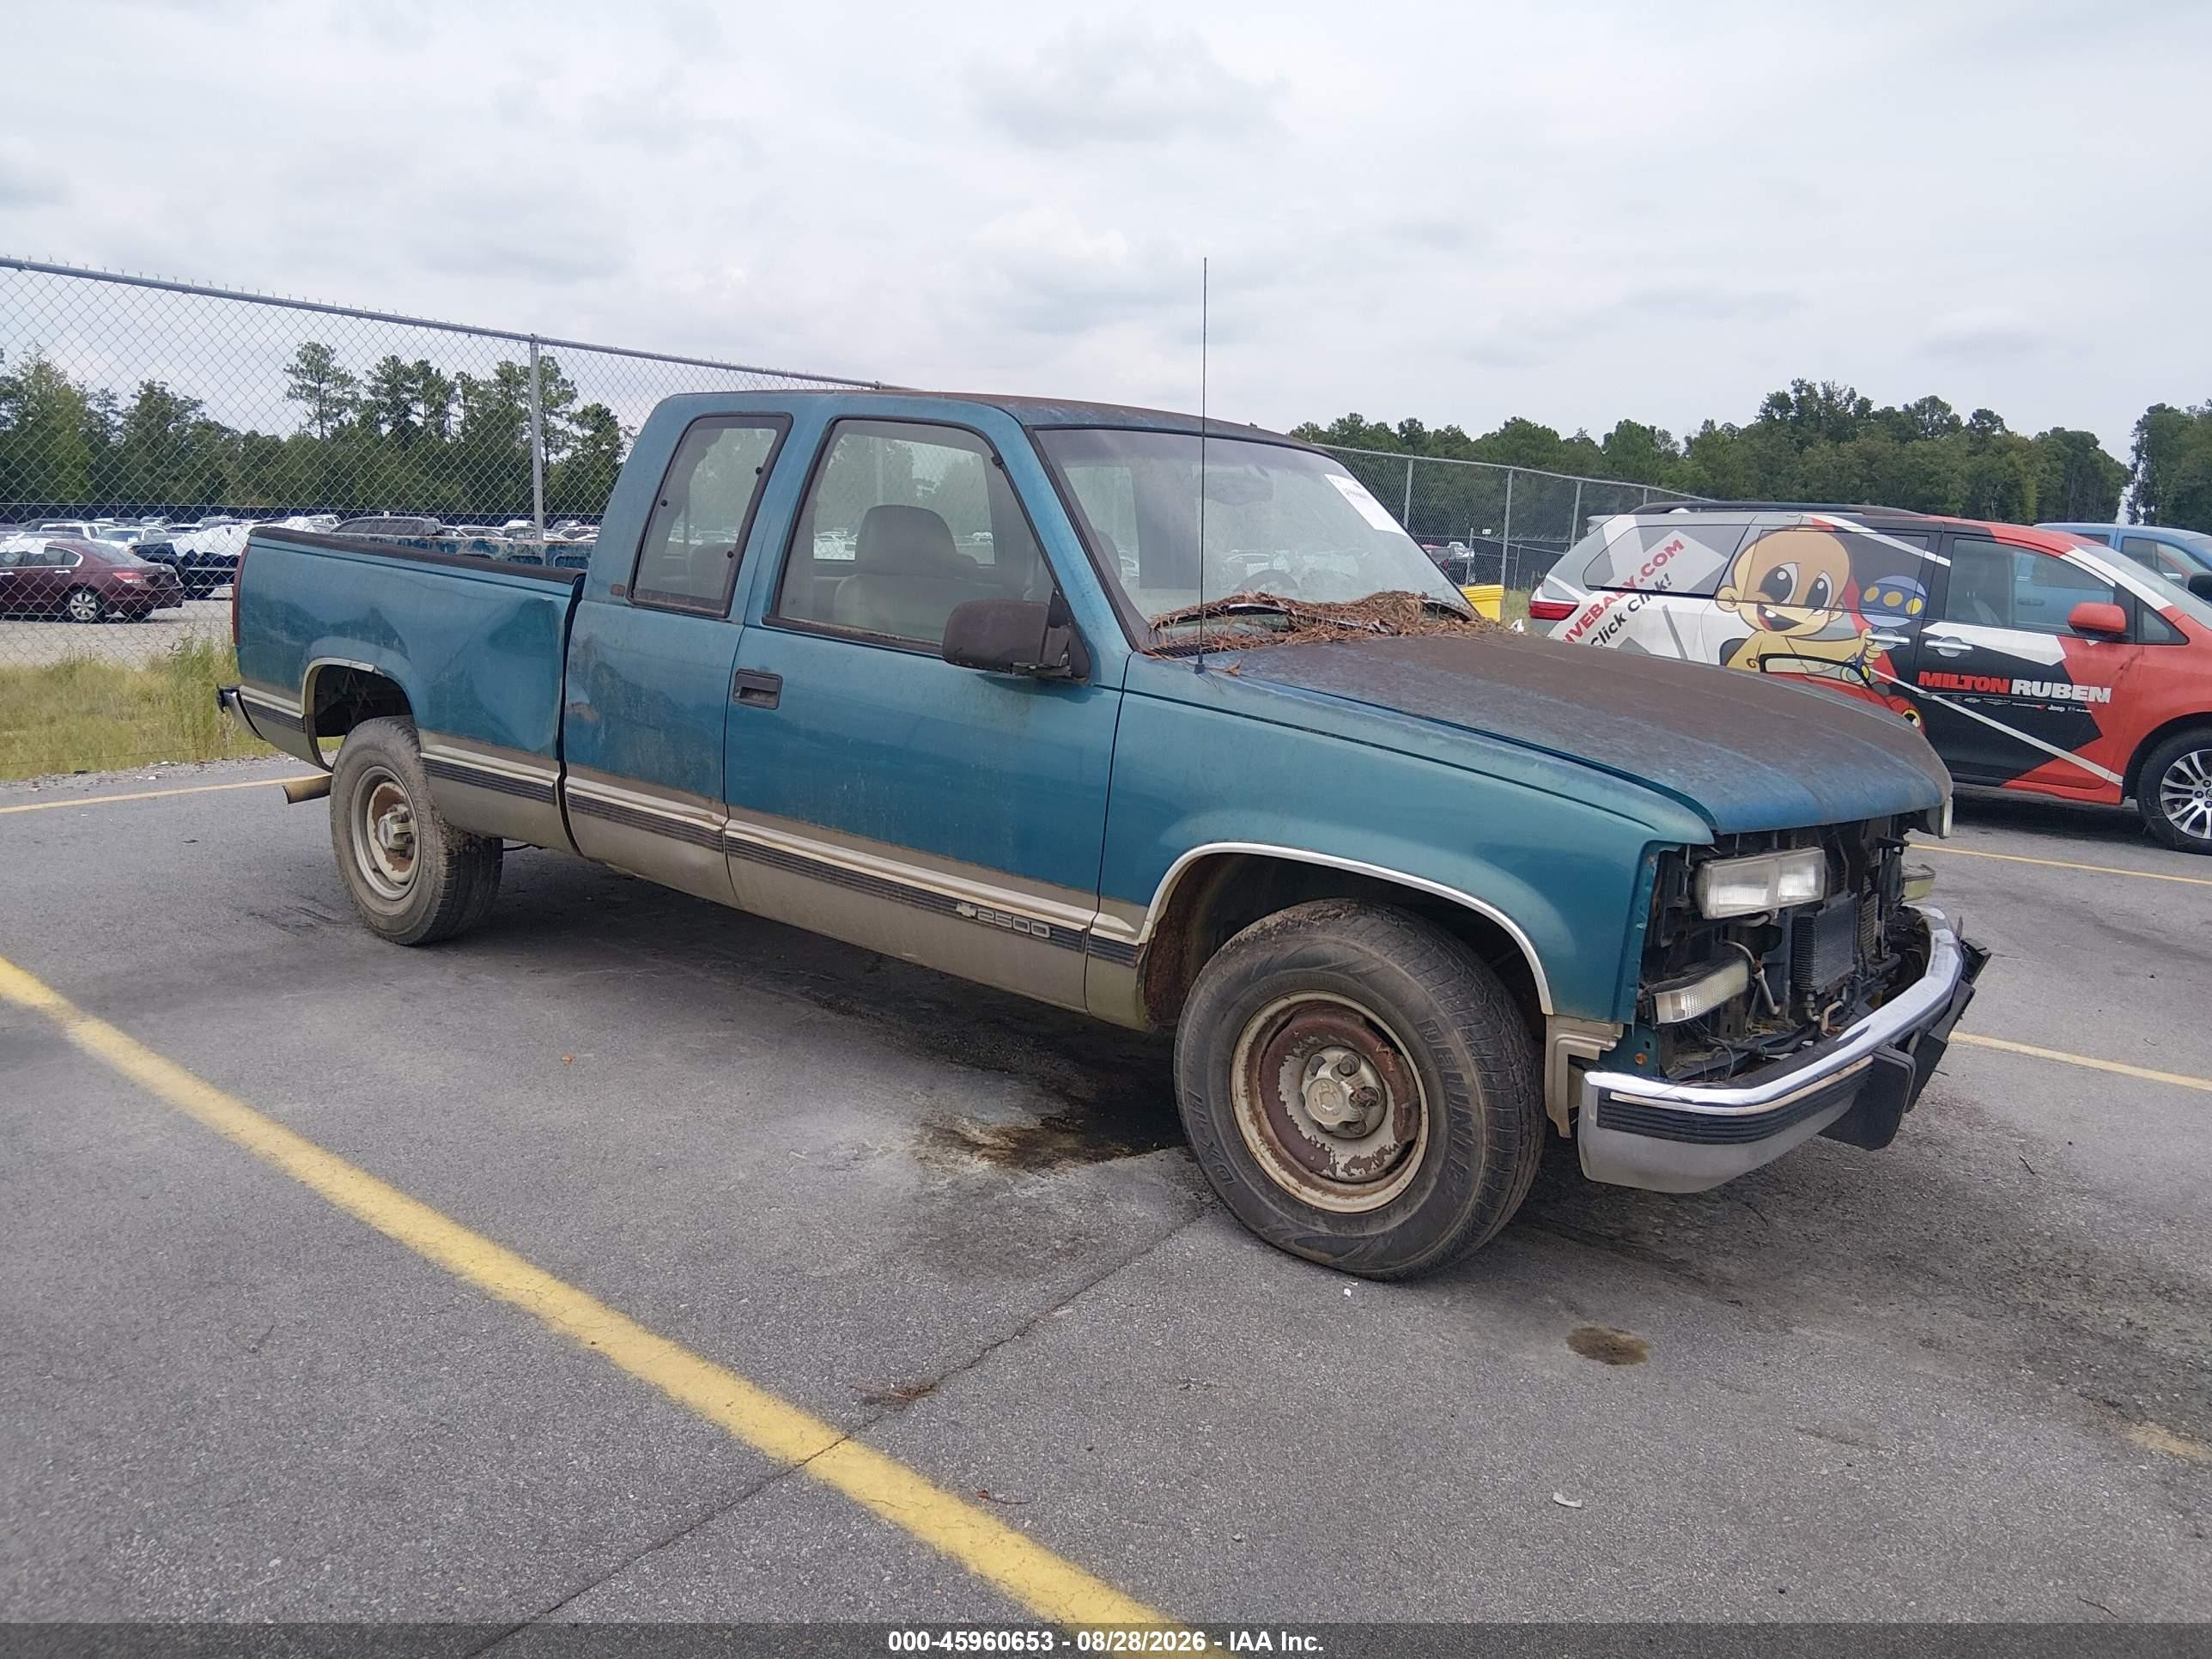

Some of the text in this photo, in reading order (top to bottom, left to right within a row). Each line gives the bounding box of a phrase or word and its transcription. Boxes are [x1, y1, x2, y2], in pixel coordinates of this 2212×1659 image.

[1627, 572, 1672, 612] Clik!
[1917, 671, 2112, 703] MILTON RUBEN
[2047, 704, 2065, 713] Jeep
[977, 908, 1051, 939] 2500
